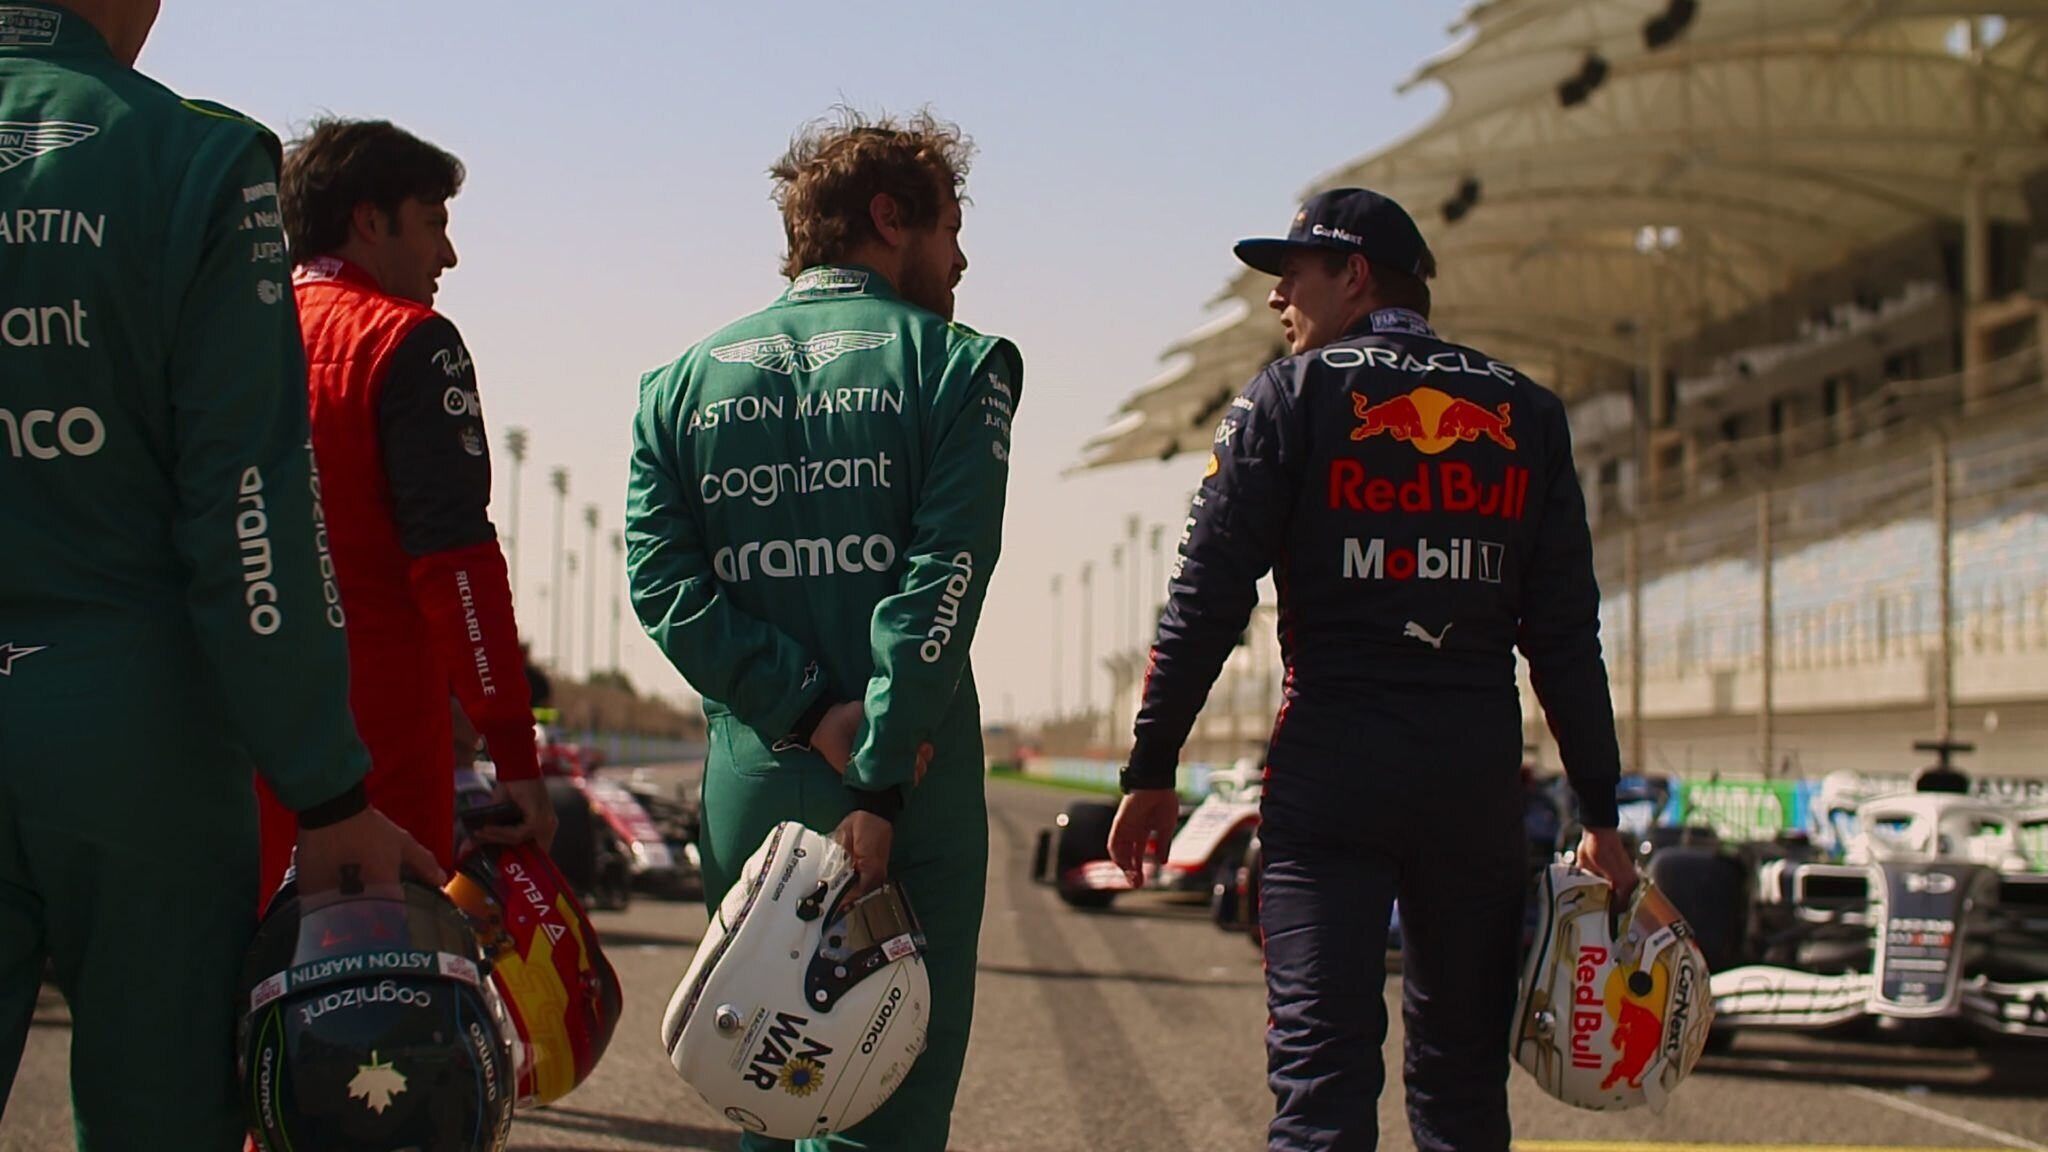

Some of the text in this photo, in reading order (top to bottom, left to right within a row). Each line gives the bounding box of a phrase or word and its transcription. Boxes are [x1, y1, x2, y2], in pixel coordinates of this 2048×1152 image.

[1, 299, 90, 348] ant
[1320, 347, 1517, 387] ORACLE
[686, 388, 904, 436] ASTON MARTIN
[701, 452, 891, 507] cognizant
[1328, 458, 1529, 521] Red Bull
[237, 465, 281, 635] aramco
[714, 534, 895, 582] aramco
[1342, 537, 1471, 580] Mobil
[456, 570, 496, 697] RICHARD MILLE
[920, 551, 972, 663] aramco
[505, 863, 550, 917] VELAS
[291, 955, 363, 986] MARTIN
[369, 952, 432, 969] ASTON
[301, 980, 431, 1025] cognizant
[862, 986, 901, 1055] aramco
[1572, 945, 1608, 1070] Red Bull
[1667, 964, 1694, 1051] CarNext
[470, 1022, 497, 1102] aramco
[743, 1012, 808, 1090] WAR
[260, 1047, 274, 1129] aramco
